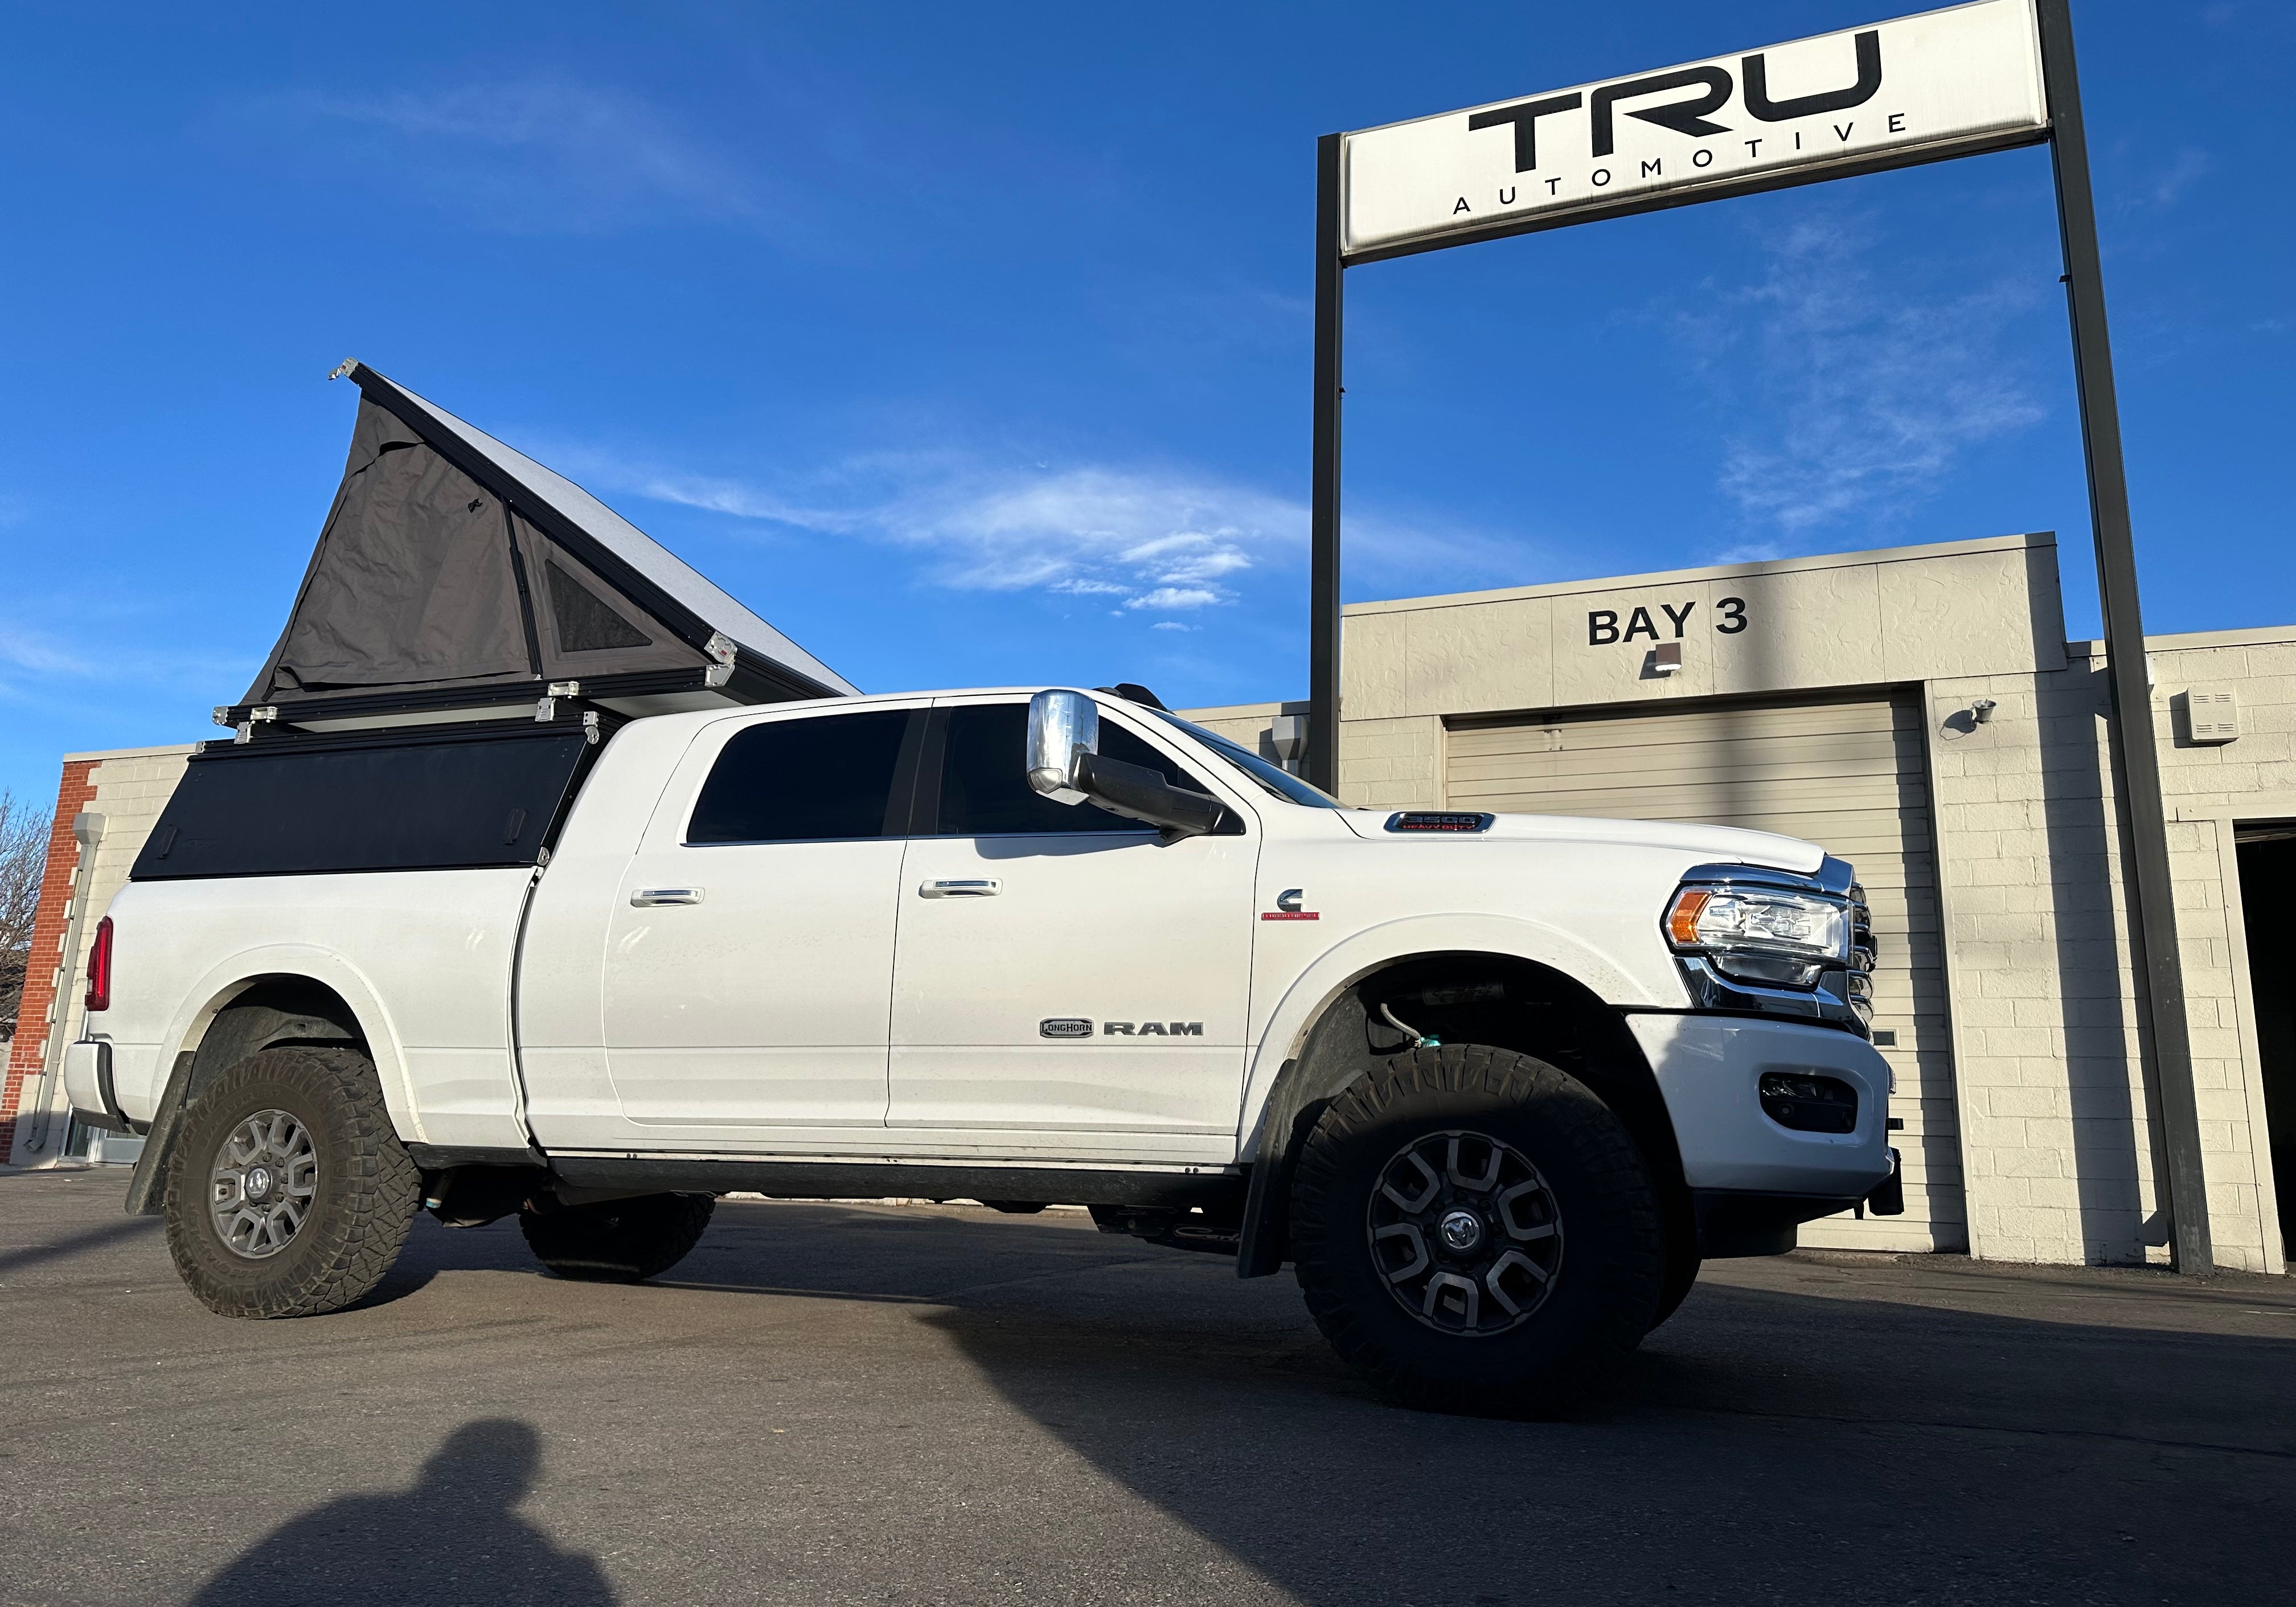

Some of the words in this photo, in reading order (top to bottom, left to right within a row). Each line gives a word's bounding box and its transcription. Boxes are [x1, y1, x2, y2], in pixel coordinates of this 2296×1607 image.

[1469, 29, 1882, 174] TRU
[1453, 113, 1906, 215] AUTOMOTIVE
[1588, 601, 1696, 646] BAY
[1716, 597, 1748, 634] 3
[1104, 1022, 1204, 1036] RAM
[1175, 1227, 1241, 1242] Carl
